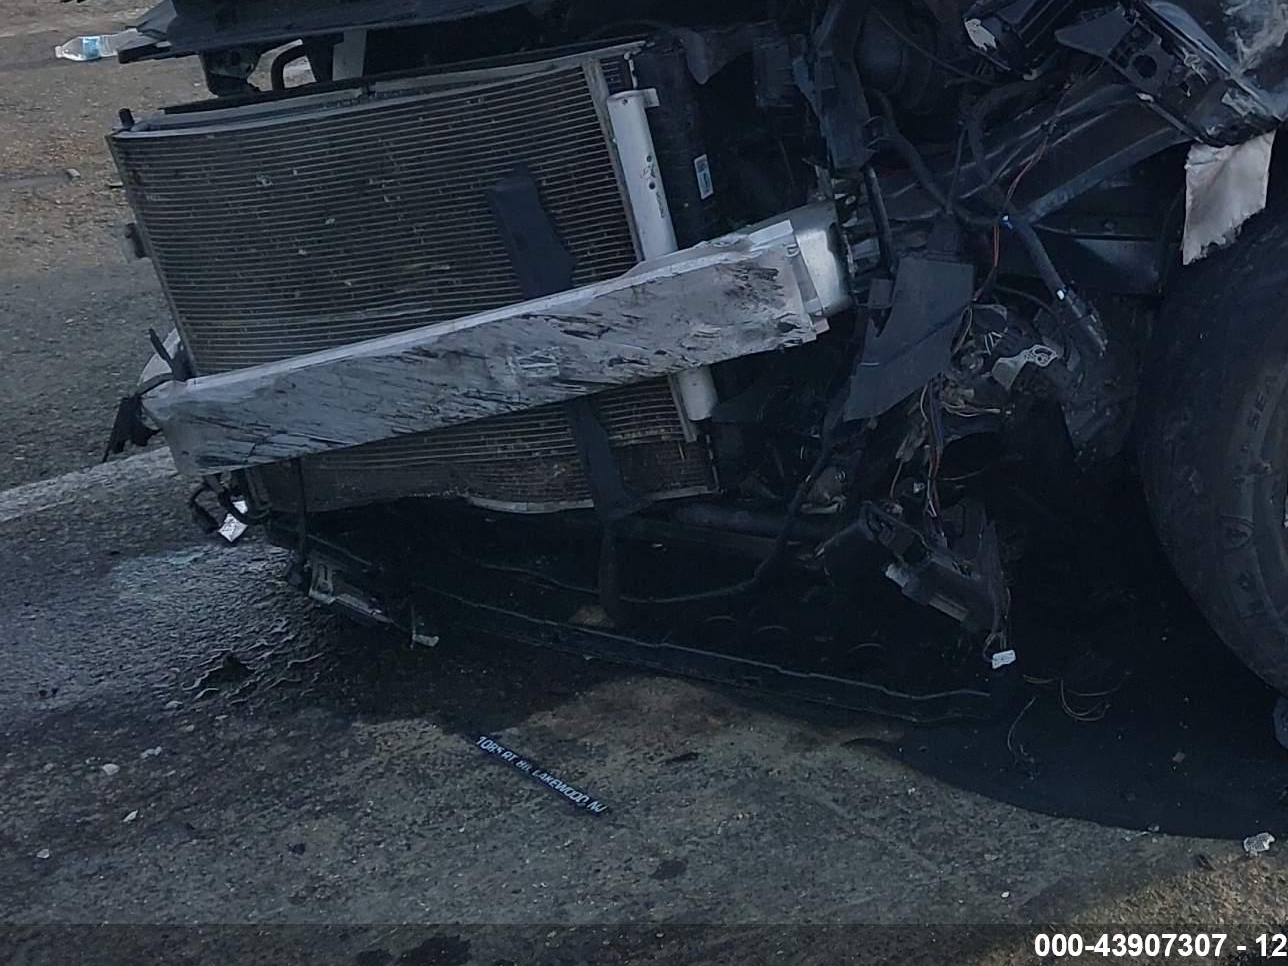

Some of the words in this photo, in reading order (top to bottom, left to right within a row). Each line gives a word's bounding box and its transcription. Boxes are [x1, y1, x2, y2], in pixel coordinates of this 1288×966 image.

[501, 751, 519, 762] RT
[532, 770, 590, 803] LAKEWOOD
[587, 801, 608, 812] NJ
